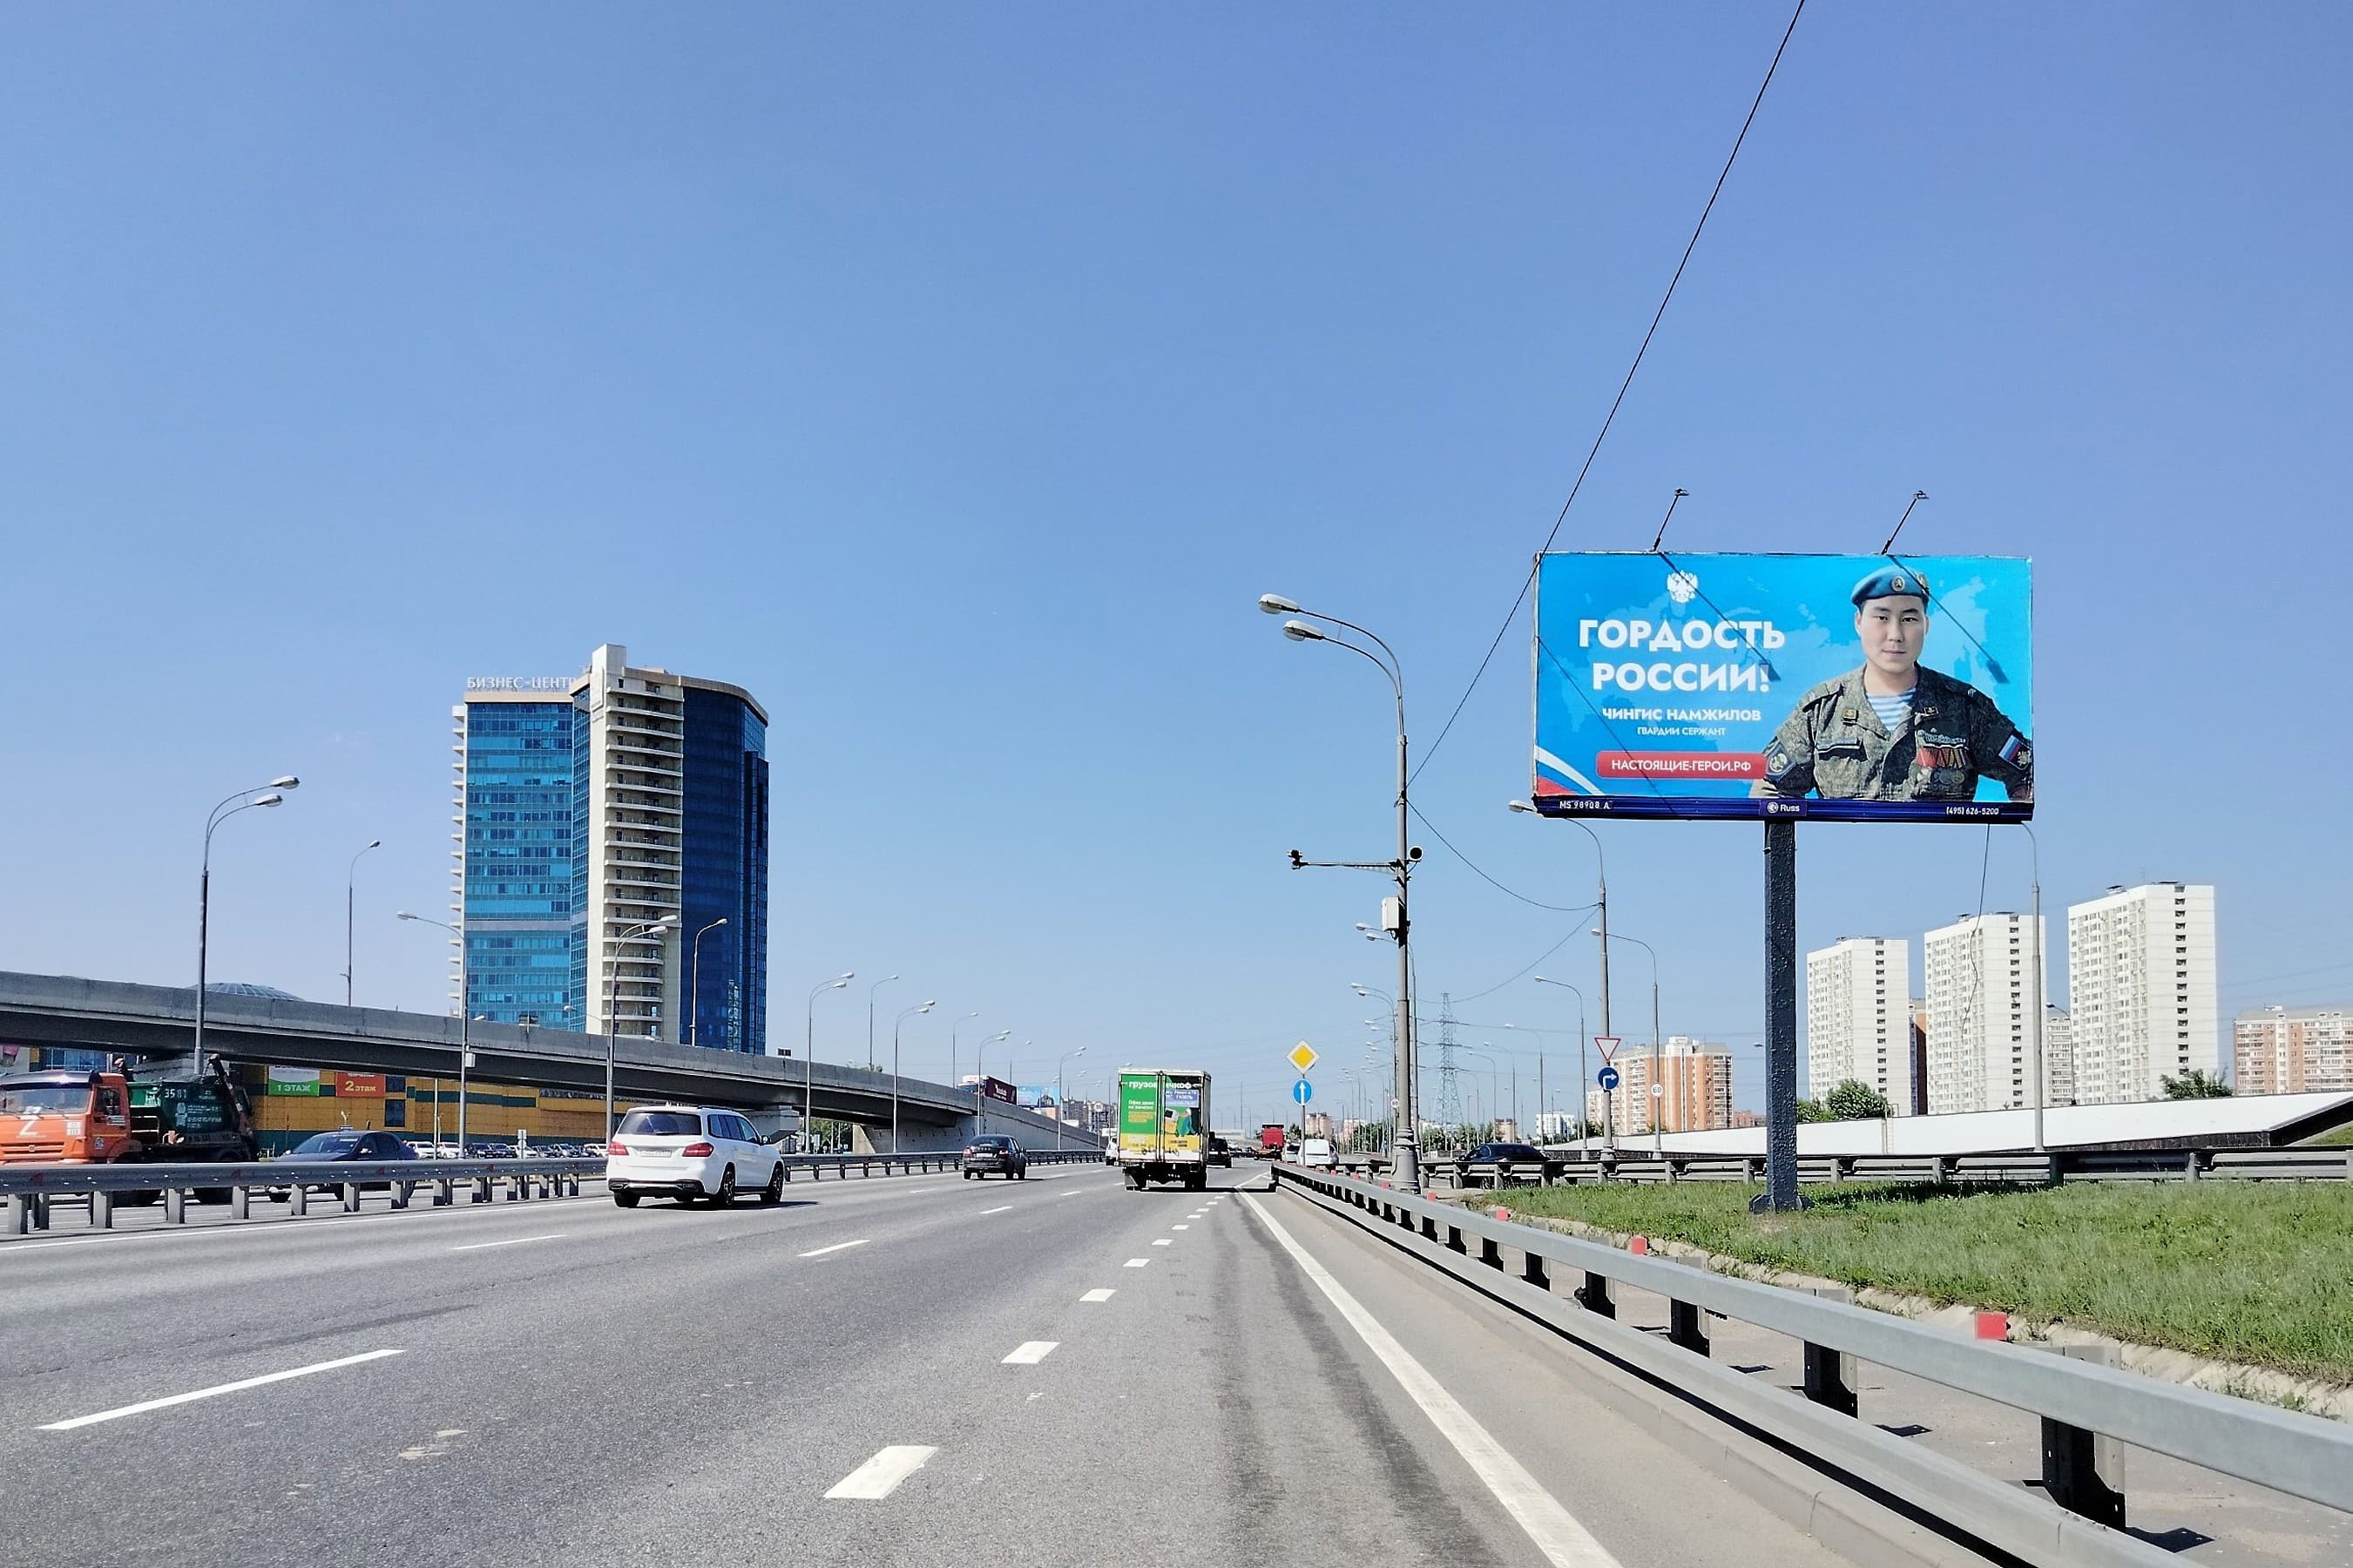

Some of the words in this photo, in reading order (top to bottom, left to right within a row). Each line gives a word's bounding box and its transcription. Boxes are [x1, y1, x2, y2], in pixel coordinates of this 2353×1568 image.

[1579, 619, 1785, 652] ГОРДОСТЬ
[1592, 662, 1769, 693] РОССИИ!
[1602, 708, 1662, 720] ЧИНГИС
[1667, 709, 1761, 721] НАМЖИЛОВ
[1637, 727, 1680, 736] ГВАРДИИ
[1681, 727, 1726, 736] СЕРЖАНТ
[1612, 760, 1751, 773] НАСТОЯЩИЕ-ГЕРОИ.РФ
[1946, 806, 1964, 814] (495)
[345, 1080, 355, 1092] 2
